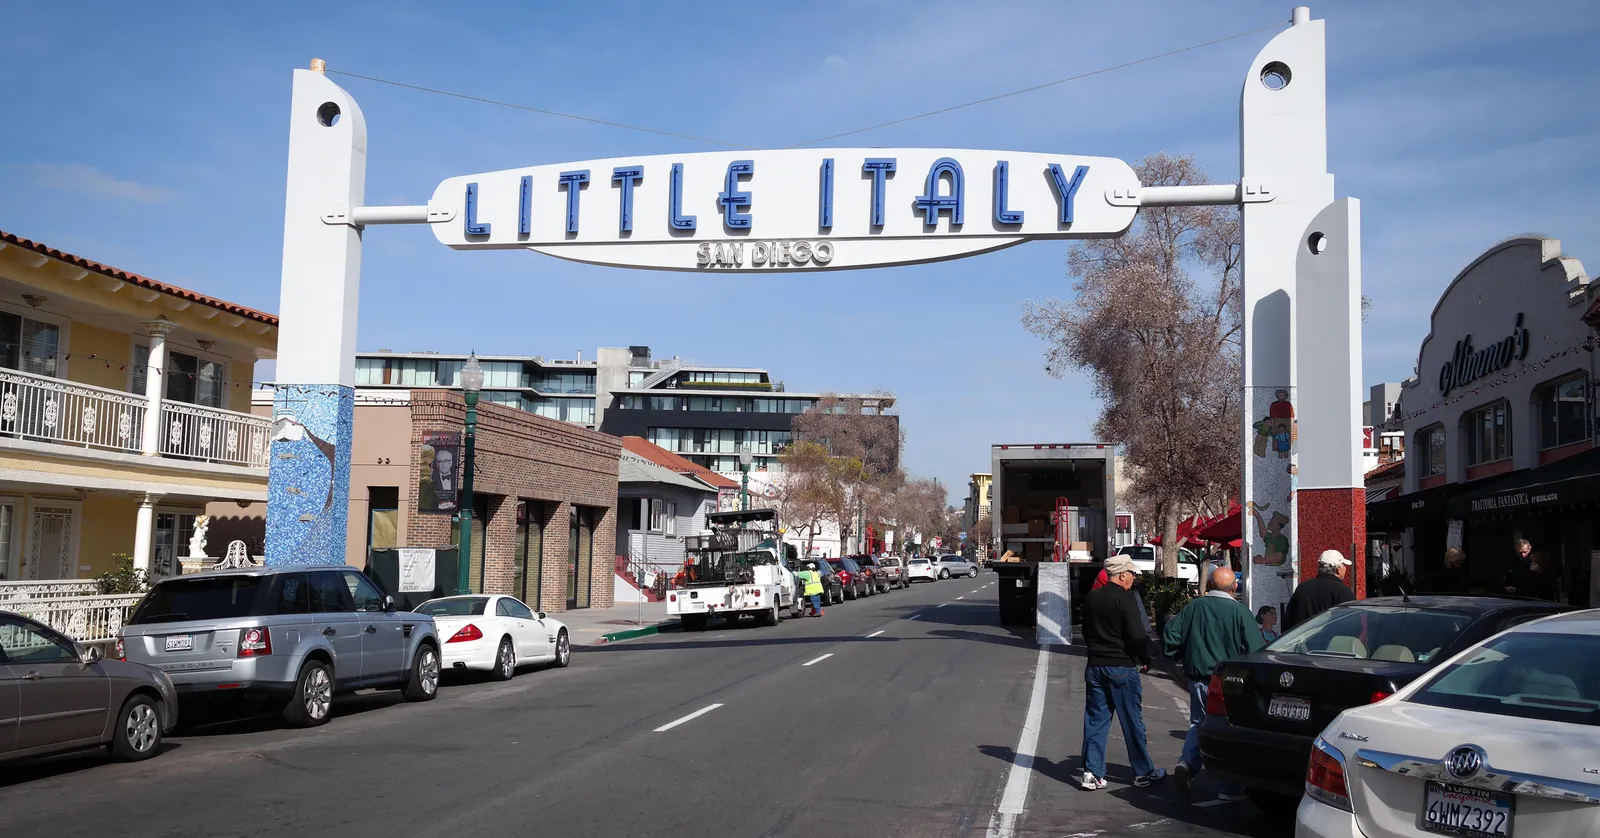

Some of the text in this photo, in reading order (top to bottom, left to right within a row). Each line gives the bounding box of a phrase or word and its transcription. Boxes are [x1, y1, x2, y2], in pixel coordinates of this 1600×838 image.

[465, 157, 1090, 235] LITTLE ITALY
[697, 240, 835, 267] SAN DIEGO
[1439, 312, 1529, 397] Mimmo's
[1471, 497, 1498, 512] TRATTORIA
[1498, 492, 1529, 508] FANTASTICA
[181, 661, 215, 669] ROVER
[1447, 784, 1491, 798] TUSTIN
[1428, 800, 1506, 836] 6WMZ392
